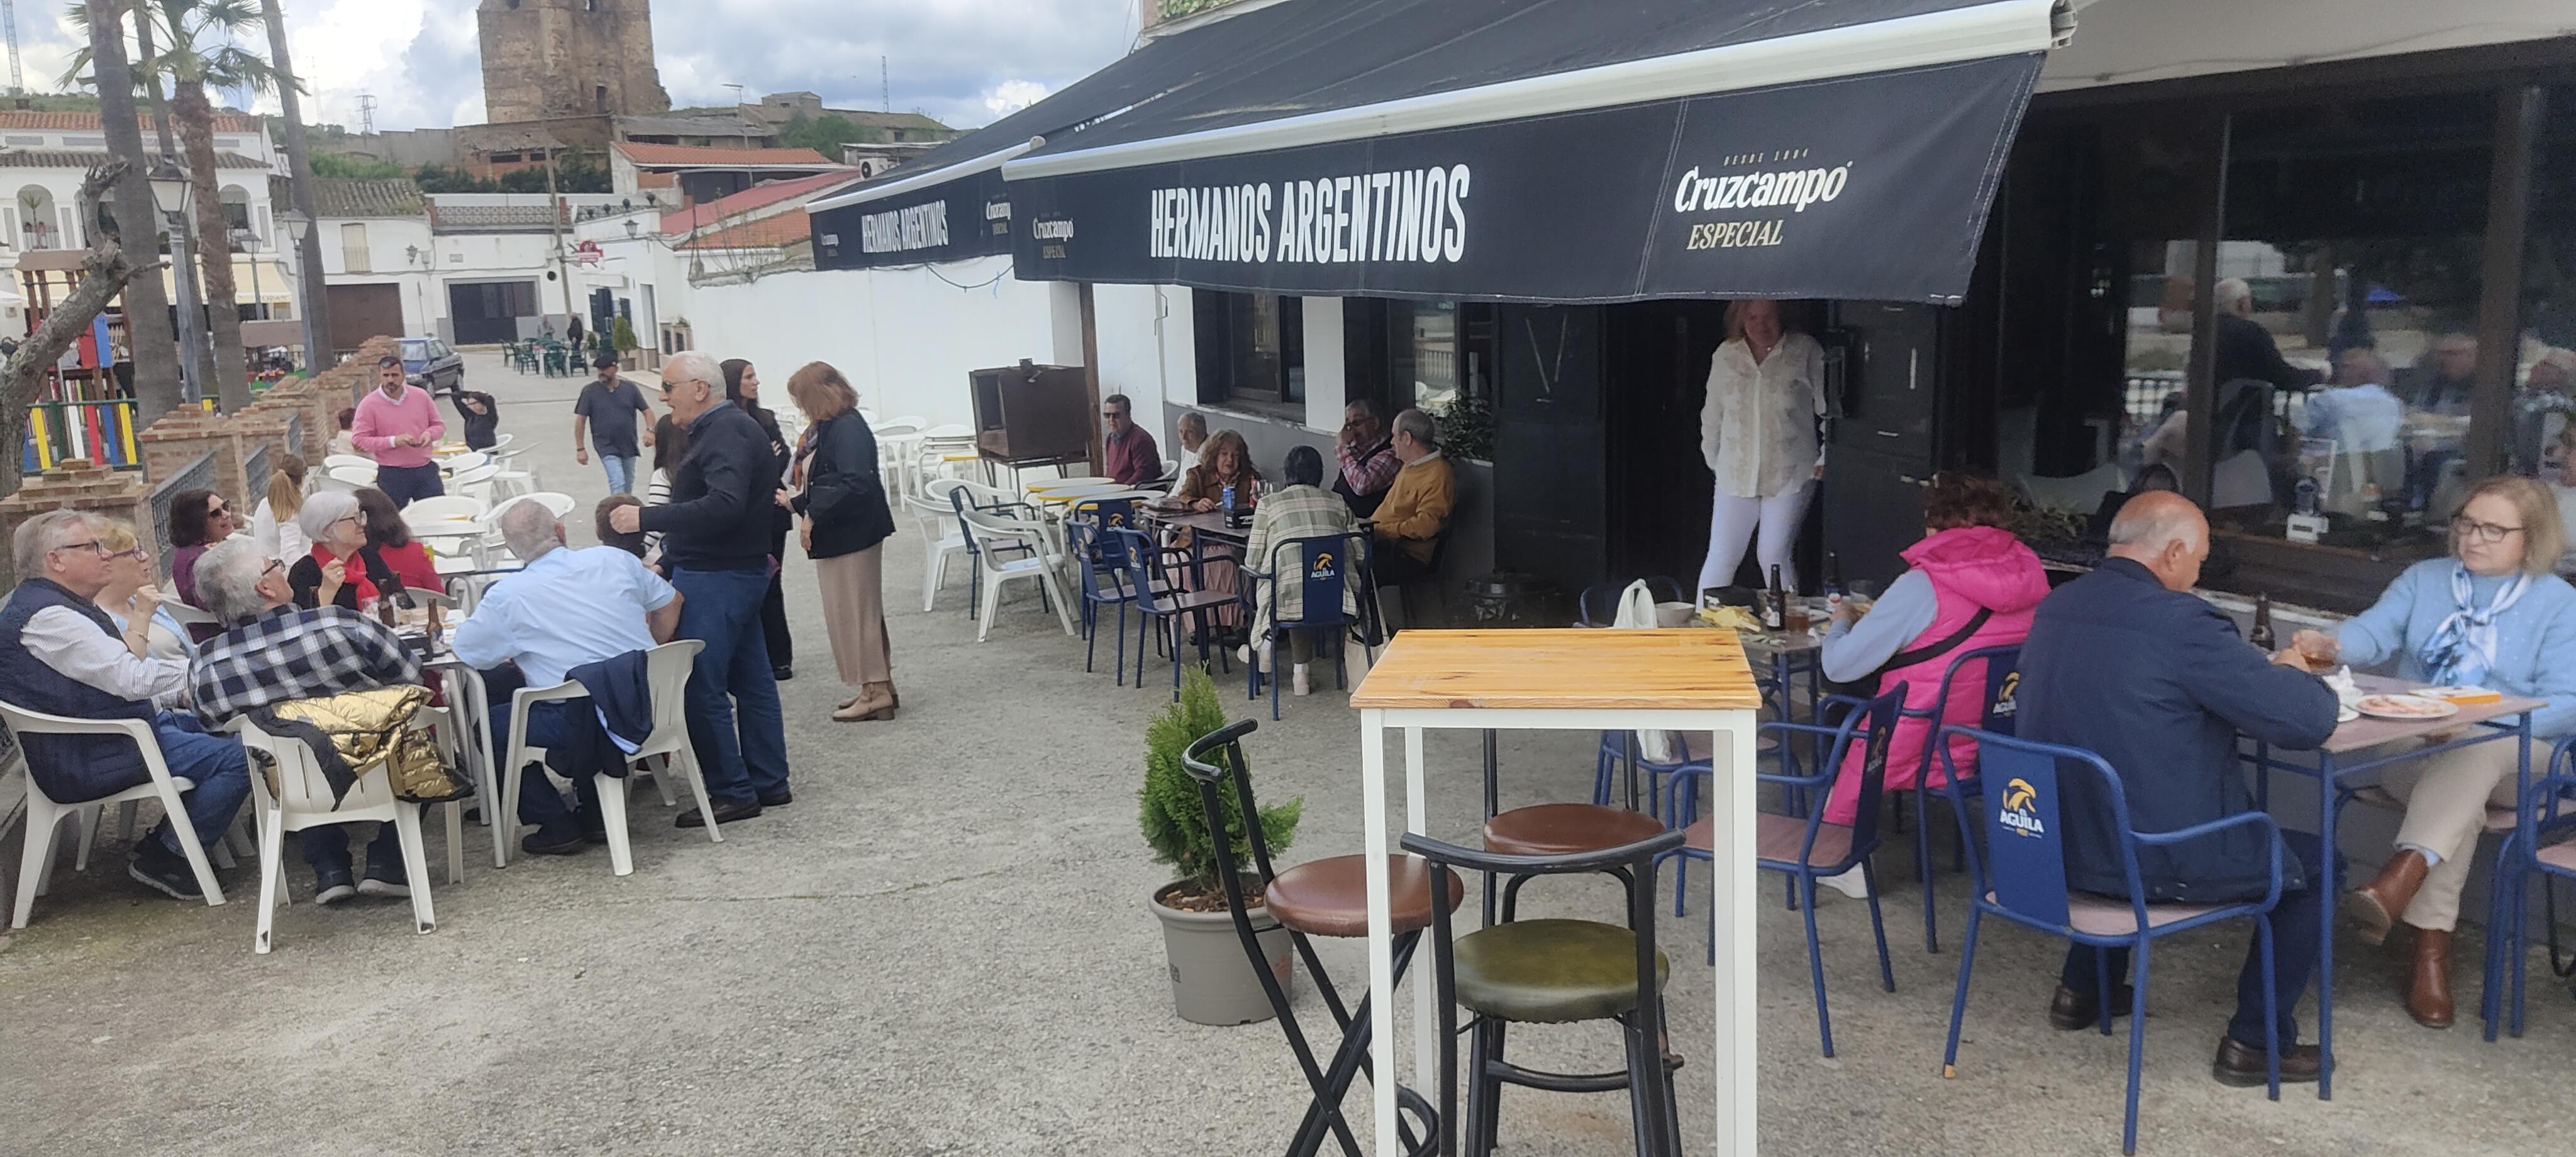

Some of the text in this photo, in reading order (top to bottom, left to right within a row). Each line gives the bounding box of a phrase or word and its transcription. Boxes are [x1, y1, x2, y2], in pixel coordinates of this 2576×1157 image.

[1151, 163, 1470, 263] HERMANOS ARGENTINOS
[1674, 166, 1849, 213] Cruzcampo
[861, 199, 948, 253] HERMANOS ARGENTINOS
[1033, 217, 1074, 242] Cruzcampo
[1685, 219, 1784, 250] ESPECIAL
